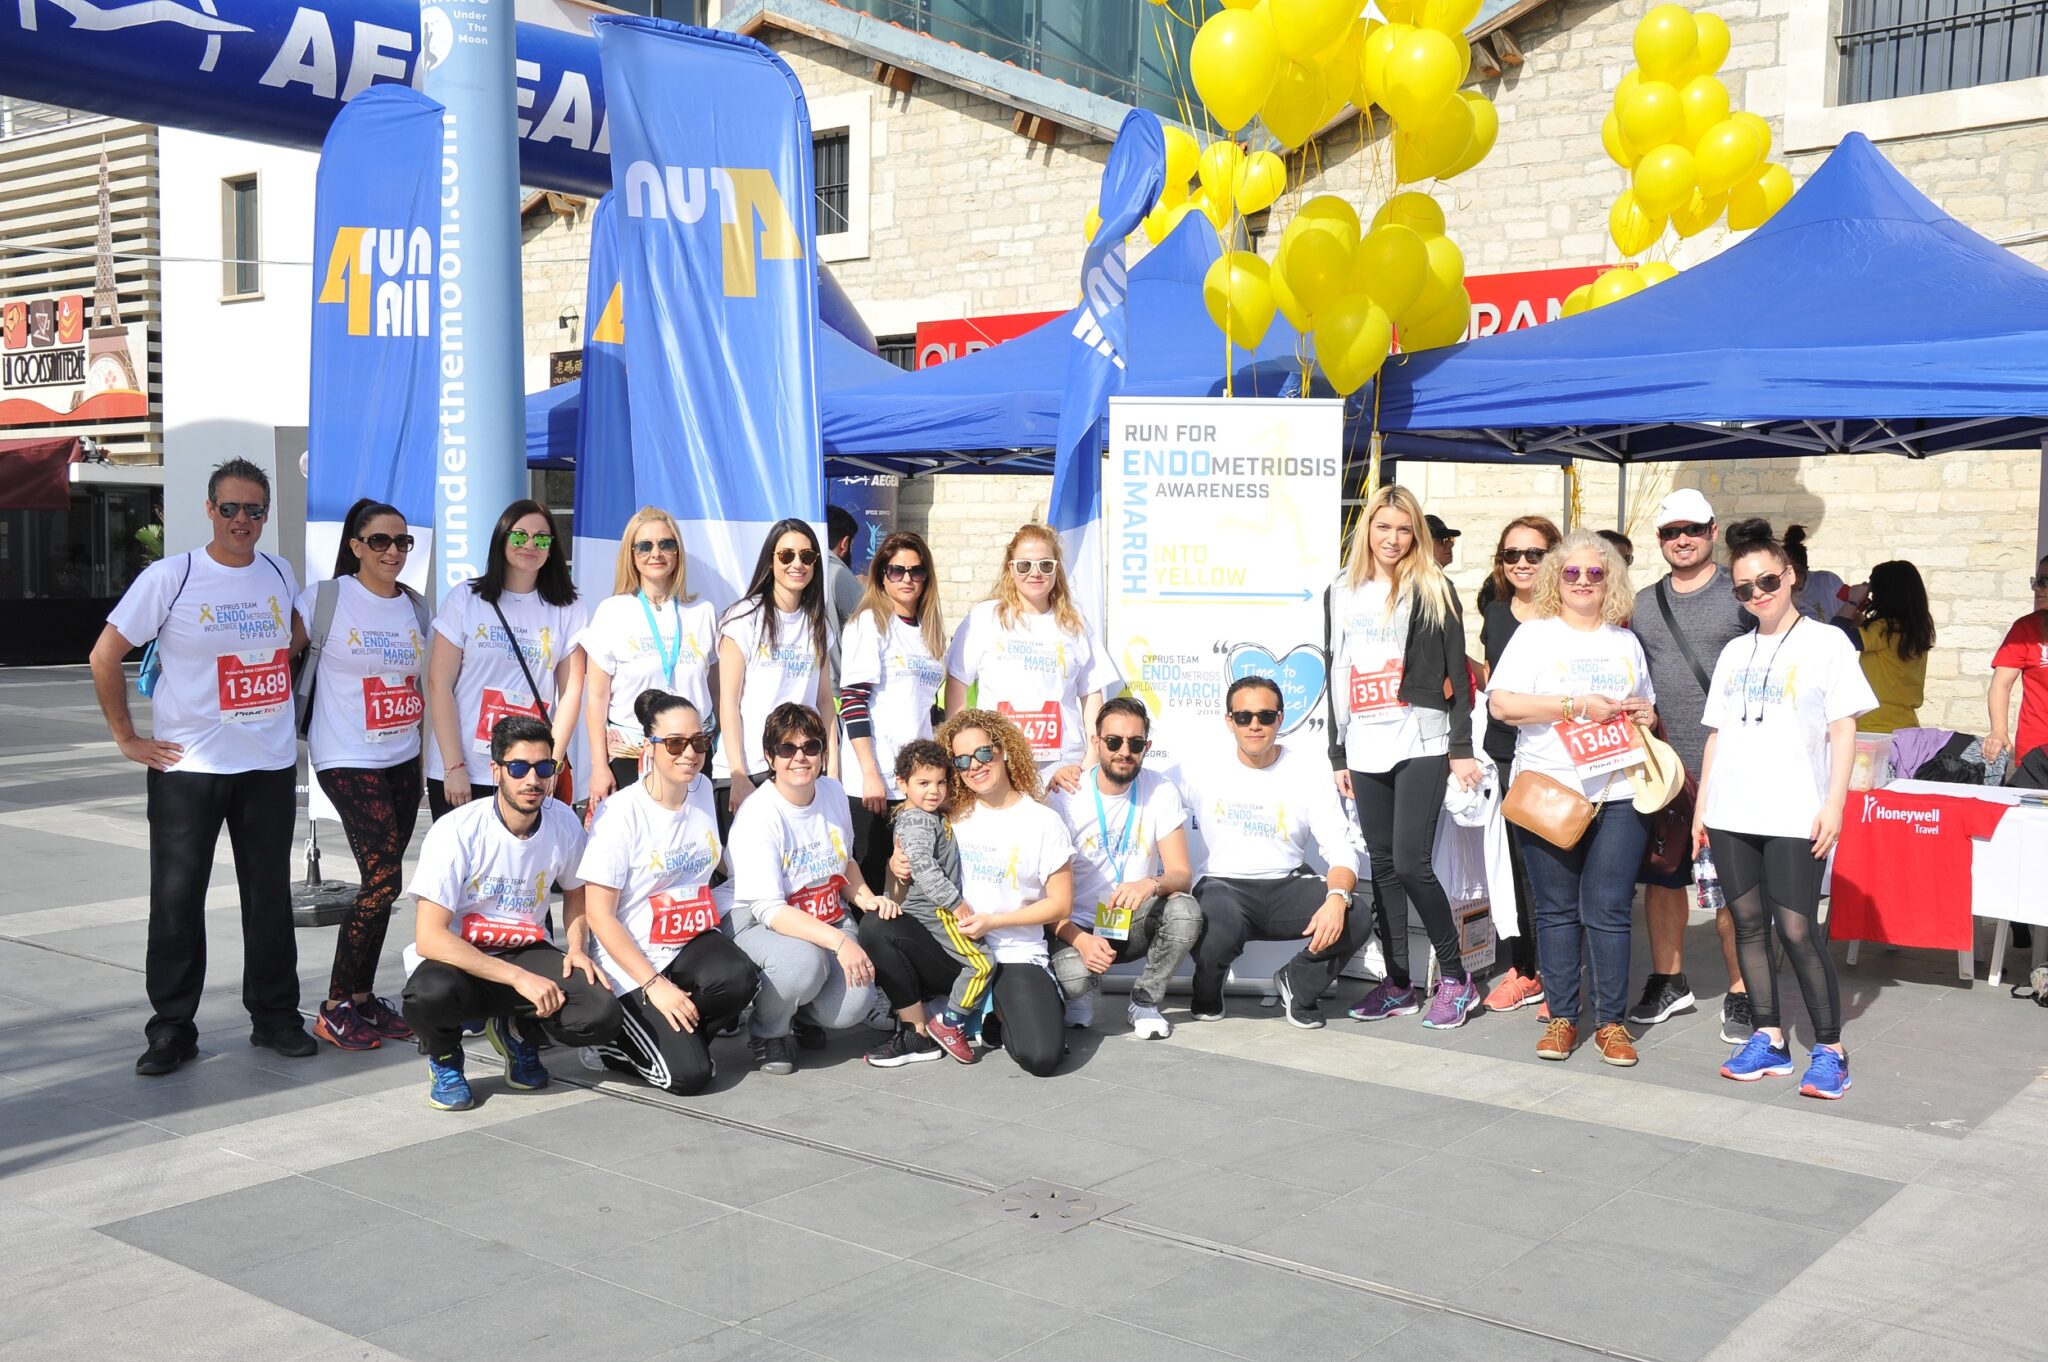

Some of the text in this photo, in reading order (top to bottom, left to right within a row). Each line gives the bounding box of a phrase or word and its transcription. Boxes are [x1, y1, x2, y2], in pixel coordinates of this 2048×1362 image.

[453, 10, 488, 20] Under
[467, 22, 488, 32] The
[458, 34, 488, 45] Moon
[1125, 424, 1217, 442] RUN FOR
[1155, 482, 1270, 498] AWARENESS
[1122, 481, 1148, 594] MARCH
[1153, 544, 1208, 564] INTO
[1154, 567, 1247, 587] YELLOW
[215, 603, 240, 611] CYPRUS
[216, 610, 246, 623] ENDO
[204, 620, 276, 633] WORLDWIDE MARCH
[240, 631, 277, 640] CYPRUS
[364, 637, 390, 648] ENDO
[383, 649, 416, 660] MARCH
[508, 645, 542, 658] MRCH
[1007, 644, 1032, 655] ENDO
[1024, 655, 1056, 668] MARCH
[1142, 654, 1199, 664] CYPRUS TEAM
[1142, 664, 1221, 681] ENDO METRIOSIS
[1240, 663, 1297, 679] Time to
[1591, 673, 1628, 685] MARCH
[226, 672, 287, 700] 13489
[1125, 680, 1220, 699] WORLDWIDE MARCH
[1748, 685, 1784, 698] MARCH
[1168, 698, 1221, 708] CYPRUS
[1572, 723, 1630, 754] 13481
[1876, 806, 1940, 824] Honeywell
[1243, 820, 1276, 834] MARCH
[1914, 823, 1939, 835] Travel
[665, 852, 689, 870] ENDO
[972, 863, 1007, 878] MARCH
[482, 882, 512, 895] ENDO
[498, 895, 536, 908] MARCH
[496, 904, 534, 914] CYPRUS
[659, 908, 714, 935] 13491
[1102, 911, 1126, 928] VIP
